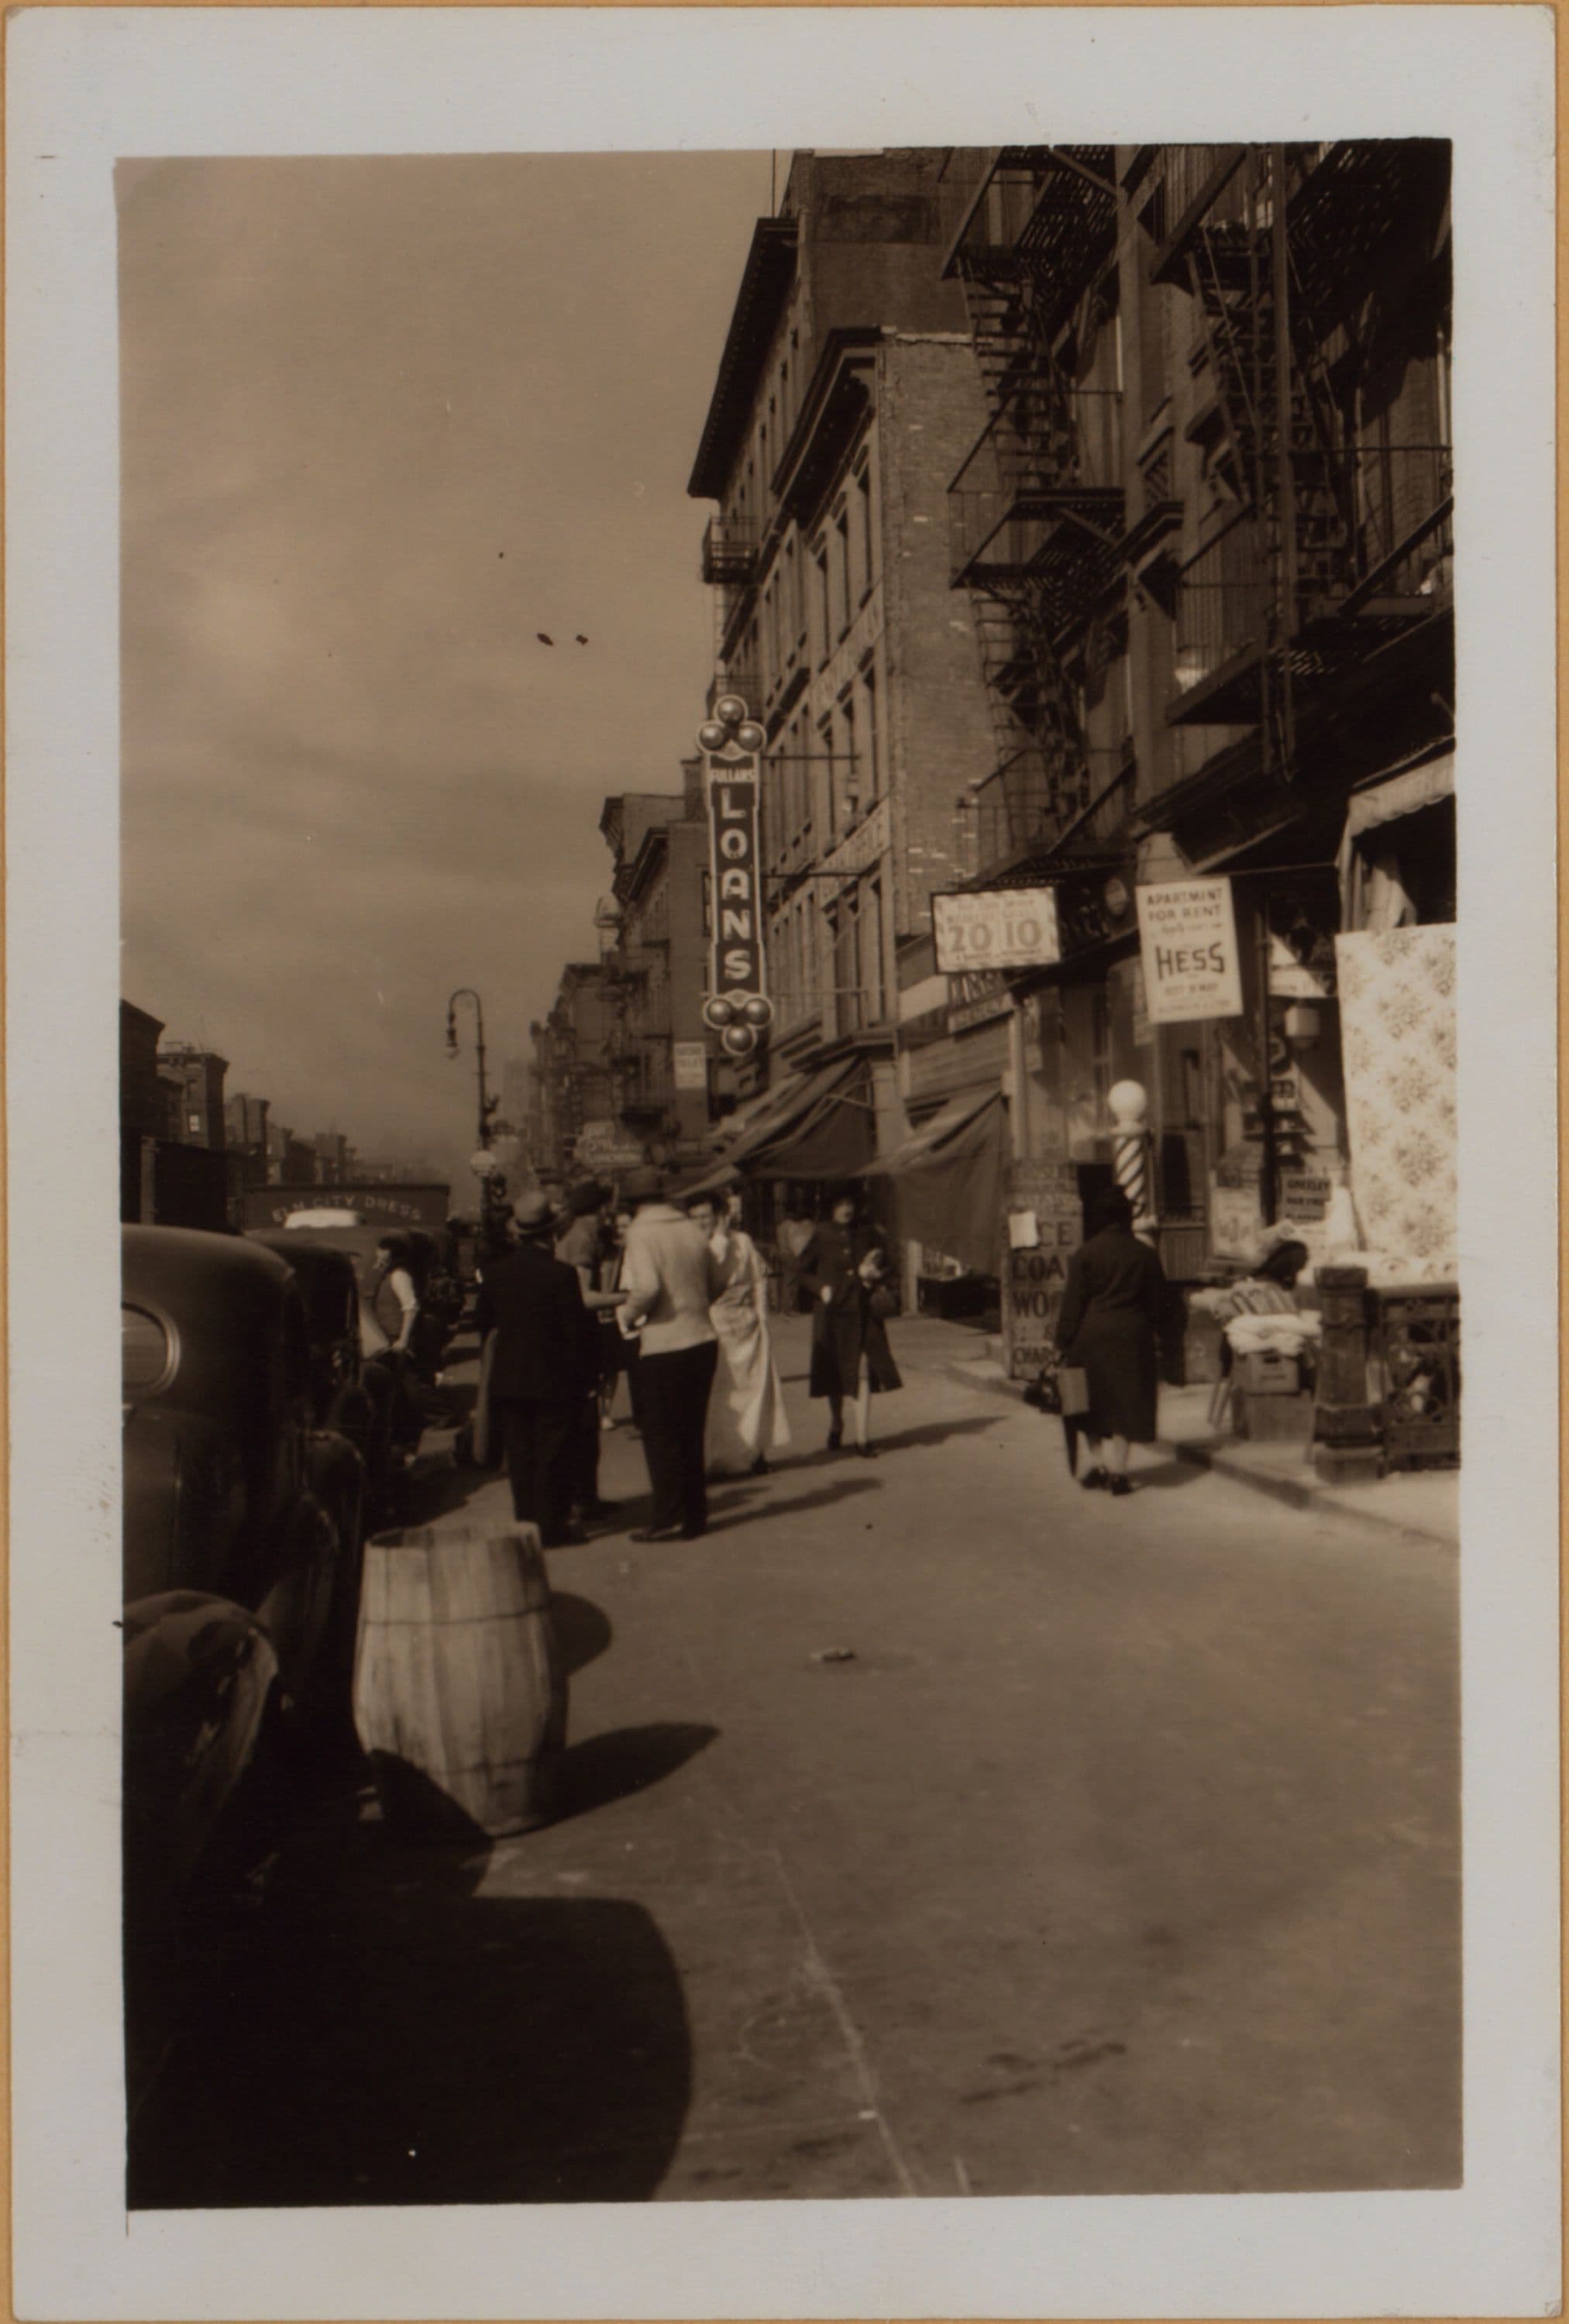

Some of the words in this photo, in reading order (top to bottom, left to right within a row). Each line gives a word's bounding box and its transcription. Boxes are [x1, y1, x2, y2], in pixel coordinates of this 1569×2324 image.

[720, 786, 752, 981] LOANS
[1148, 909, 1175, 921] FOR
[1182, 904, 1221, 920] RENT
[948, 923, 993, 951] 20
[1006, 919, 1043, 947] 10
[1154, 942, 1224, 982] HESS
[1012, 1255, 1065, 1281] COA
